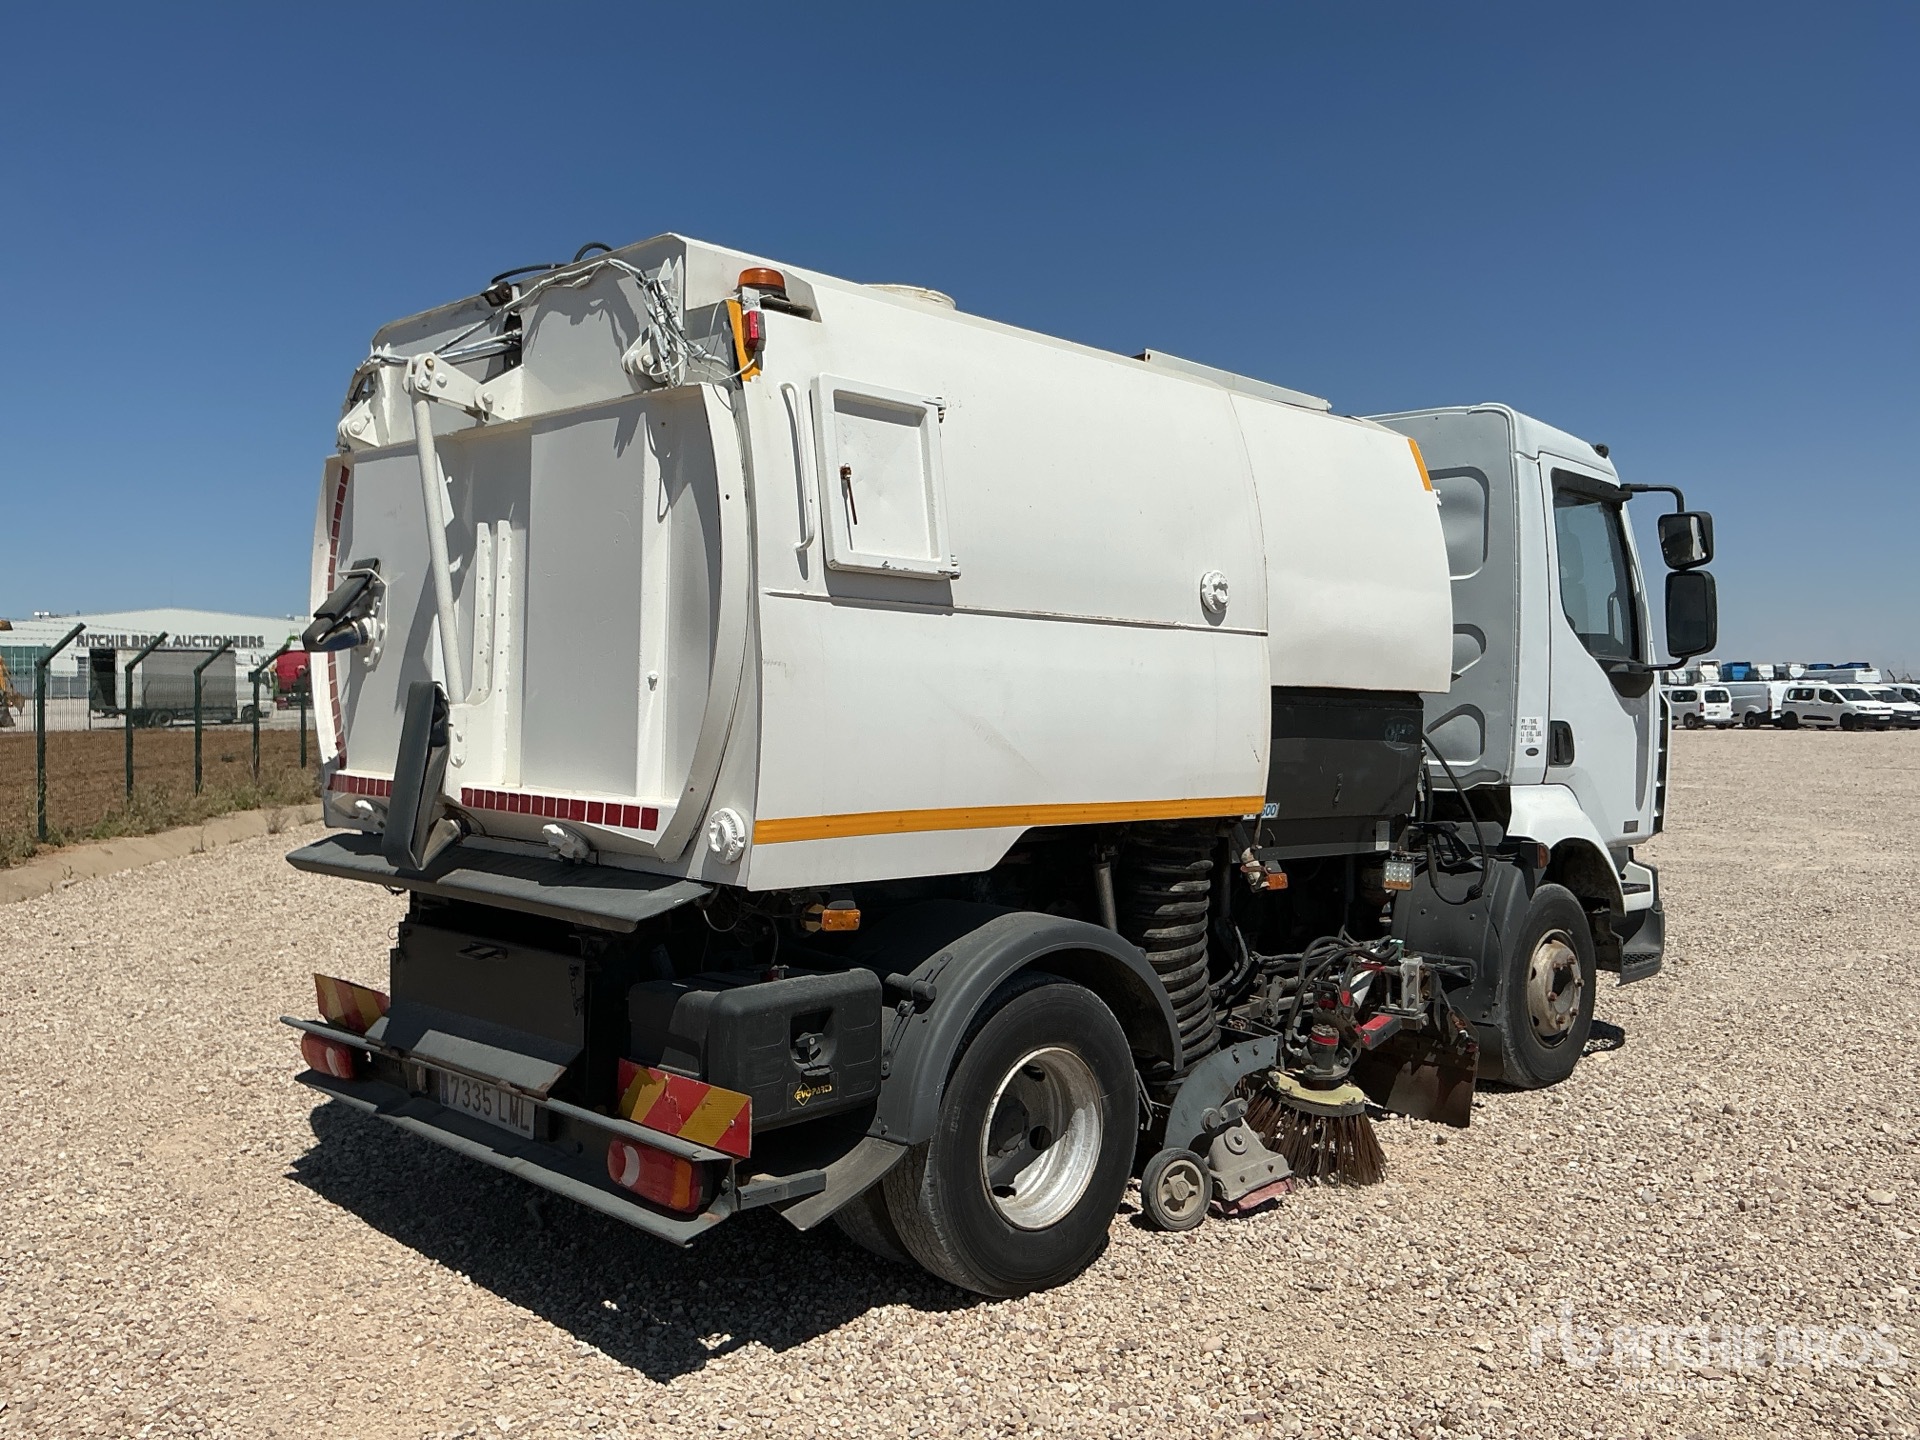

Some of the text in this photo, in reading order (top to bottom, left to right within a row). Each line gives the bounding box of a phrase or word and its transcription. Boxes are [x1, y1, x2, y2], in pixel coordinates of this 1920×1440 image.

[76, 634, 127, 647] RITCHIE
[172, 634, 264, 648] AUCTIONEERS
[450, 1076, 492, 1116] 7335
